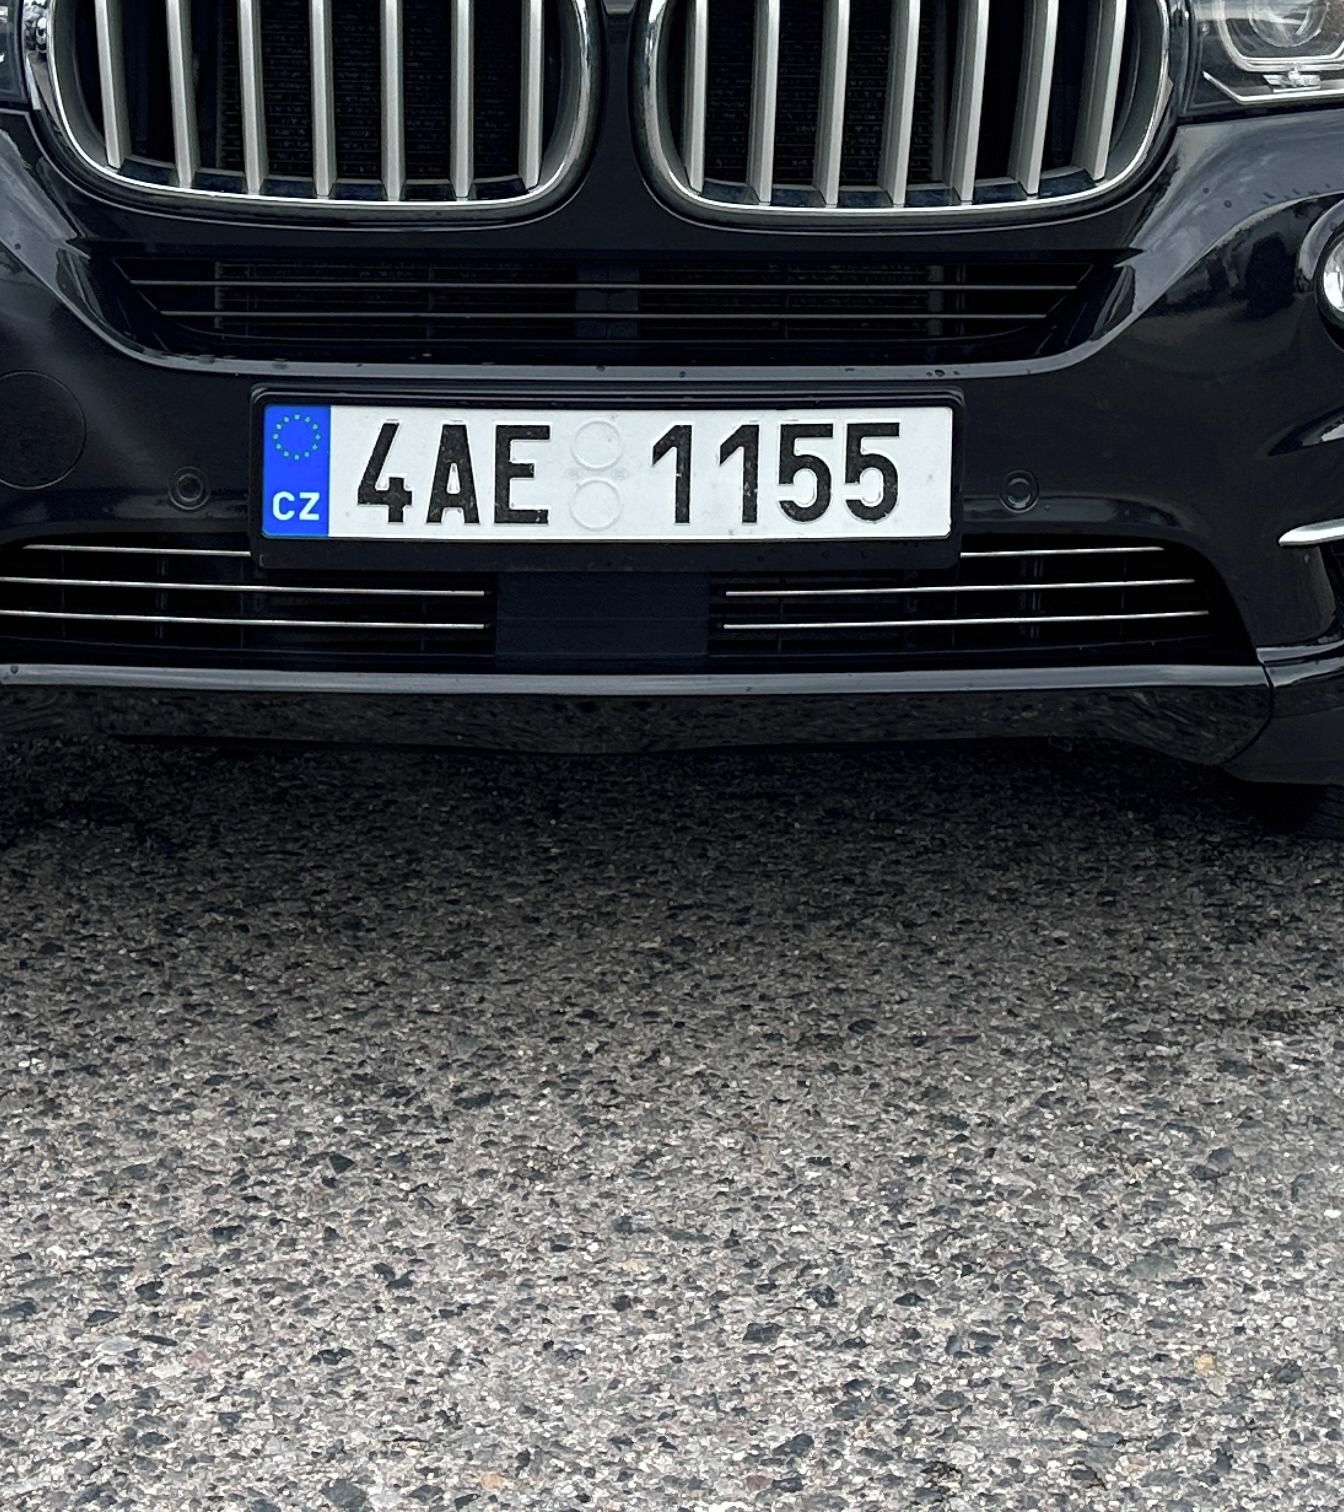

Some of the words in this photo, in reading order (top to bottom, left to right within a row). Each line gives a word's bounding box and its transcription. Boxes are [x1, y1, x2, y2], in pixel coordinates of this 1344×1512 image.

[272, 491, 320, 520] CZ
[356, 422, 552, 524] 4AE
[651, 422, 901, 524] 1155
